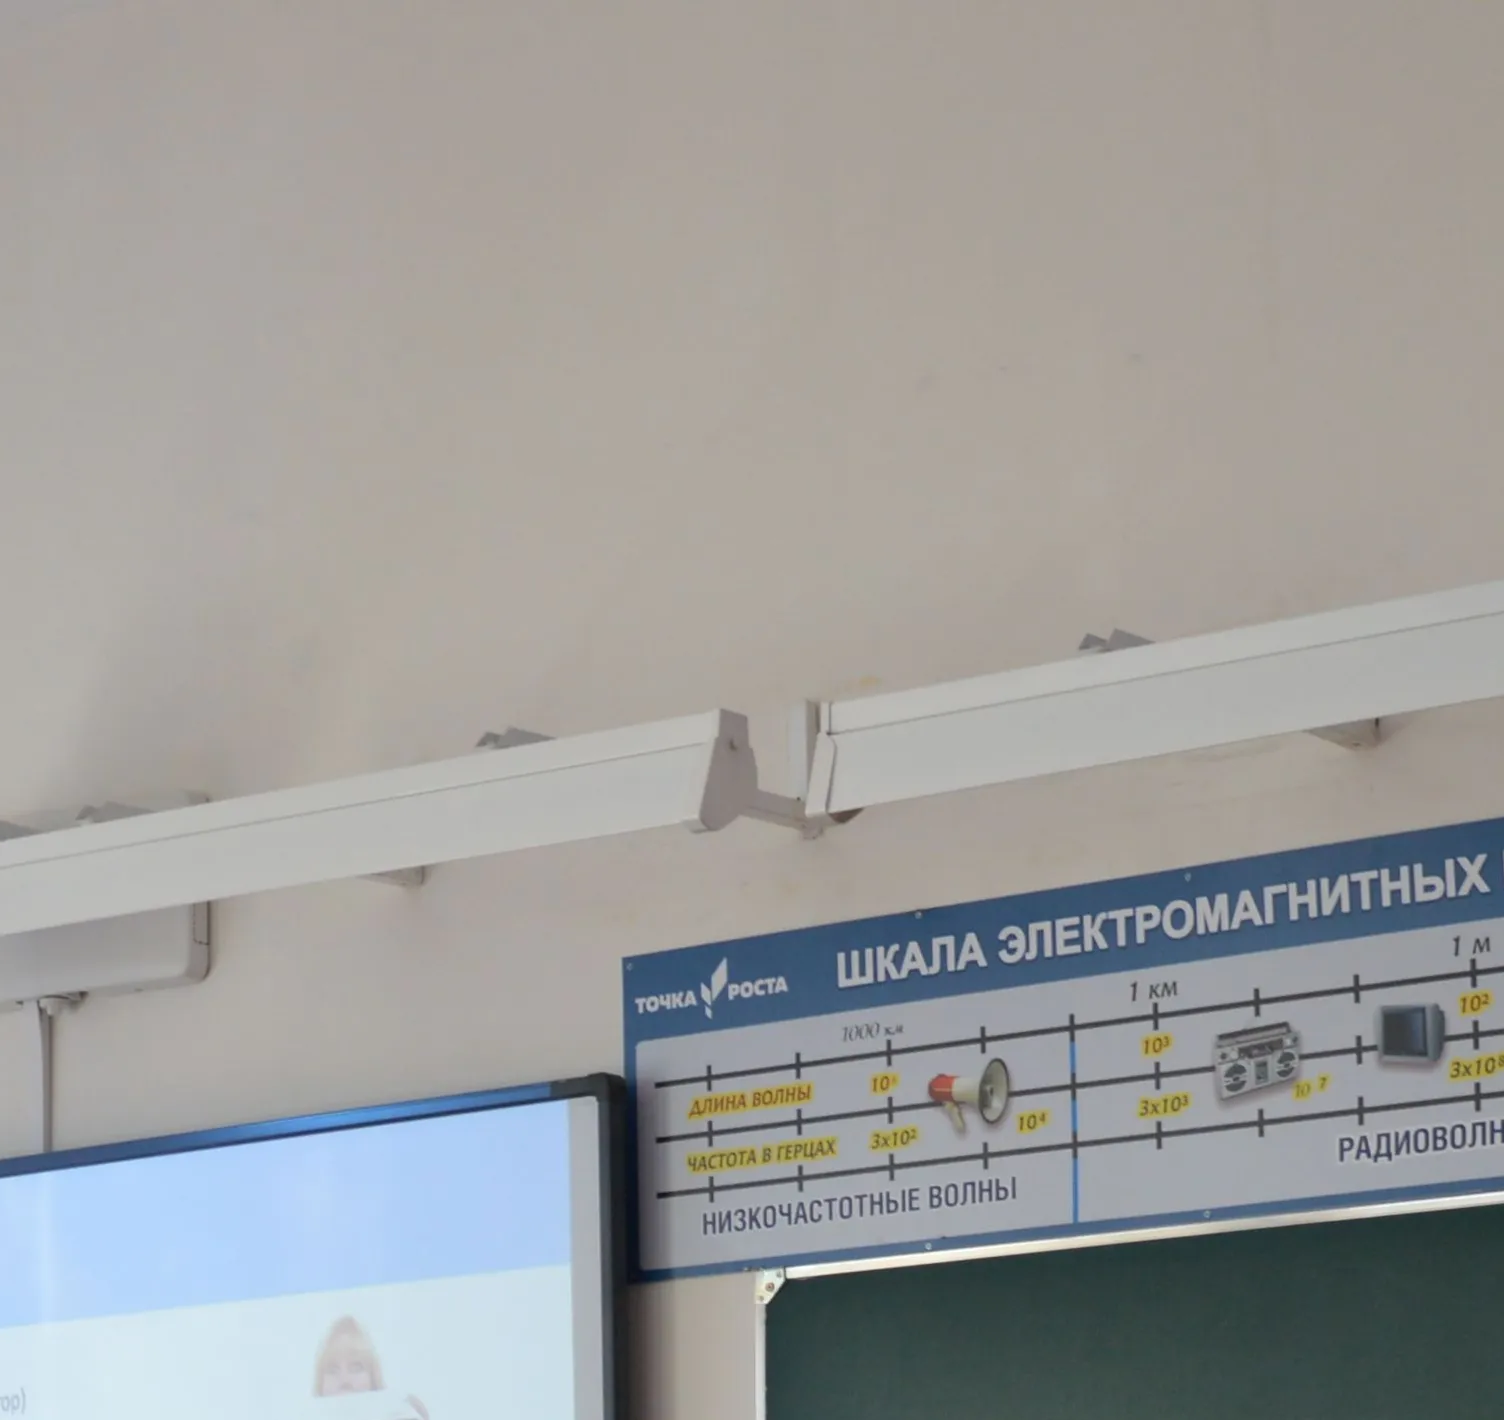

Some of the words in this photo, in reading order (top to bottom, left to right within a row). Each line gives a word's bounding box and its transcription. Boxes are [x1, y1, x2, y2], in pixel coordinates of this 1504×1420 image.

[837, 928, 988, 989] ШКАЛА
[997, 853, 1490, 967] ЭЛЕКТРОМАГНИТНЫХ
[1452, 936, 1461, 956] 1
[635, 990, 697, 1014] ТОЧКА
[727, 976, 789, 1000] РОСТА
[1129, 981, 1139, 1001] 1
[841, 1023, 880, 1042] 1000
[687, 1094, 747, 1118] ДЛИНА
[752, 1085, 811, 1107] ВОЛНЫ
[687, 1150, 757, 1173] ЧАСТОТА
[762, 1148, 773, 1163] В
[777, 1139, 837, 1161] ГЕРЦАХ
[702, 1188, 920, 1236] НИЗКОЧАСТОТНЫЕ
[929, 1177, 1017, 1210] ВОЛНЫ
